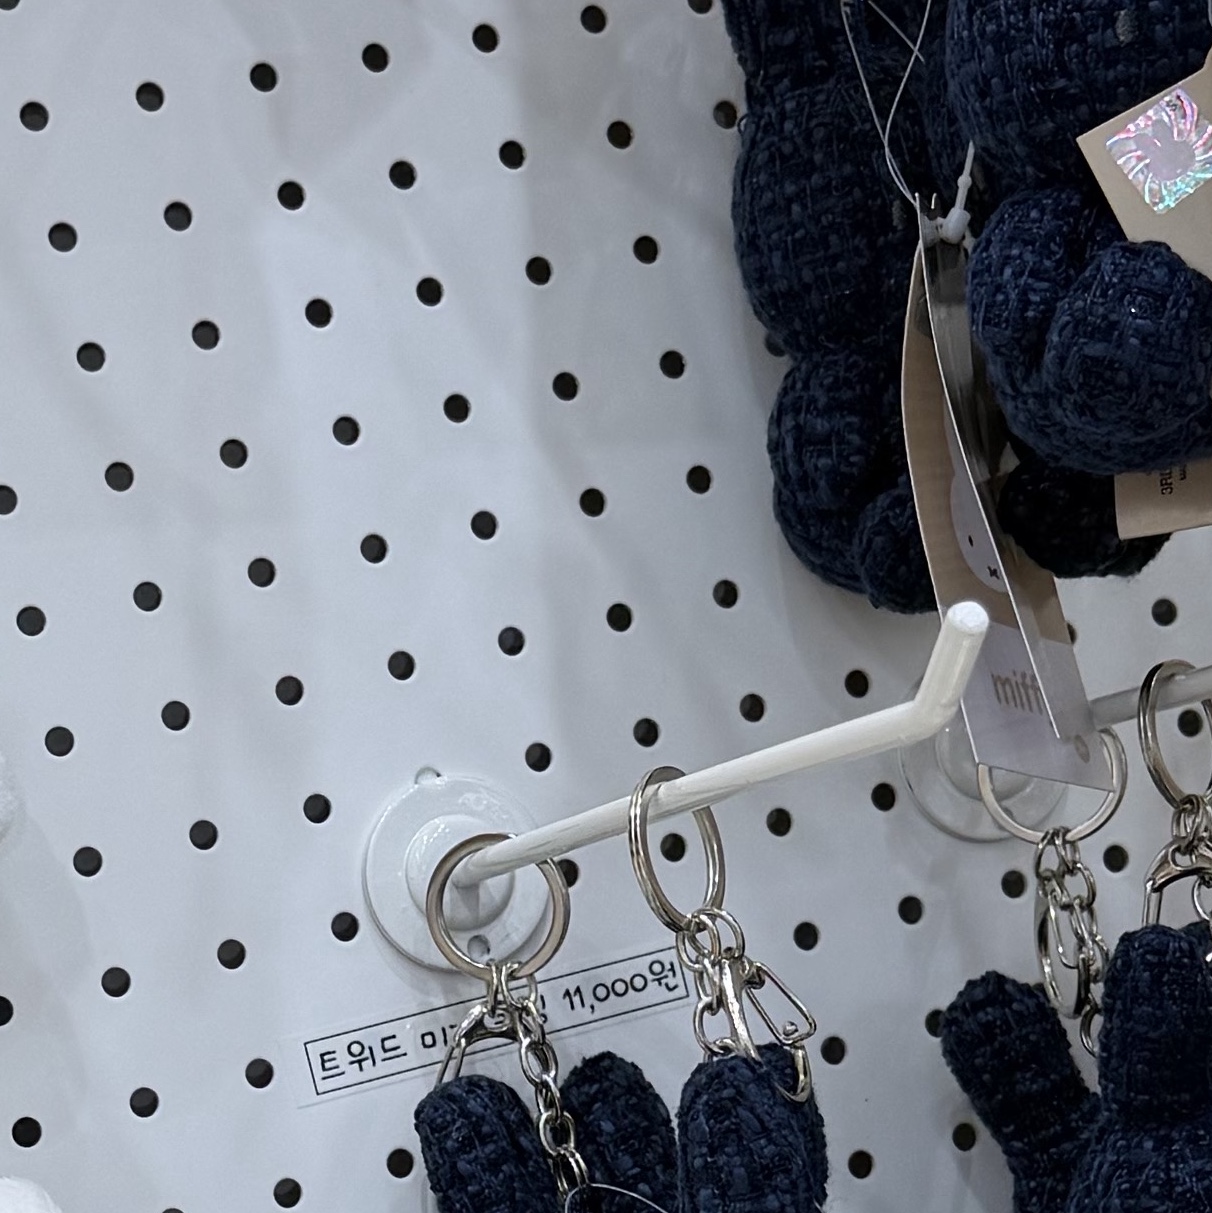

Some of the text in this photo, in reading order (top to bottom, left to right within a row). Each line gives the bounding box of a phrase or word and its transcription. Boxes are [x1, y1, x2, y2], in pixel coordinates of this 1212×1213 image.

[990, 669, 1044, 716] miff
[319, 1034, 408, 1081] 트위드
[562, 959, 681, 1015] 11,000원
